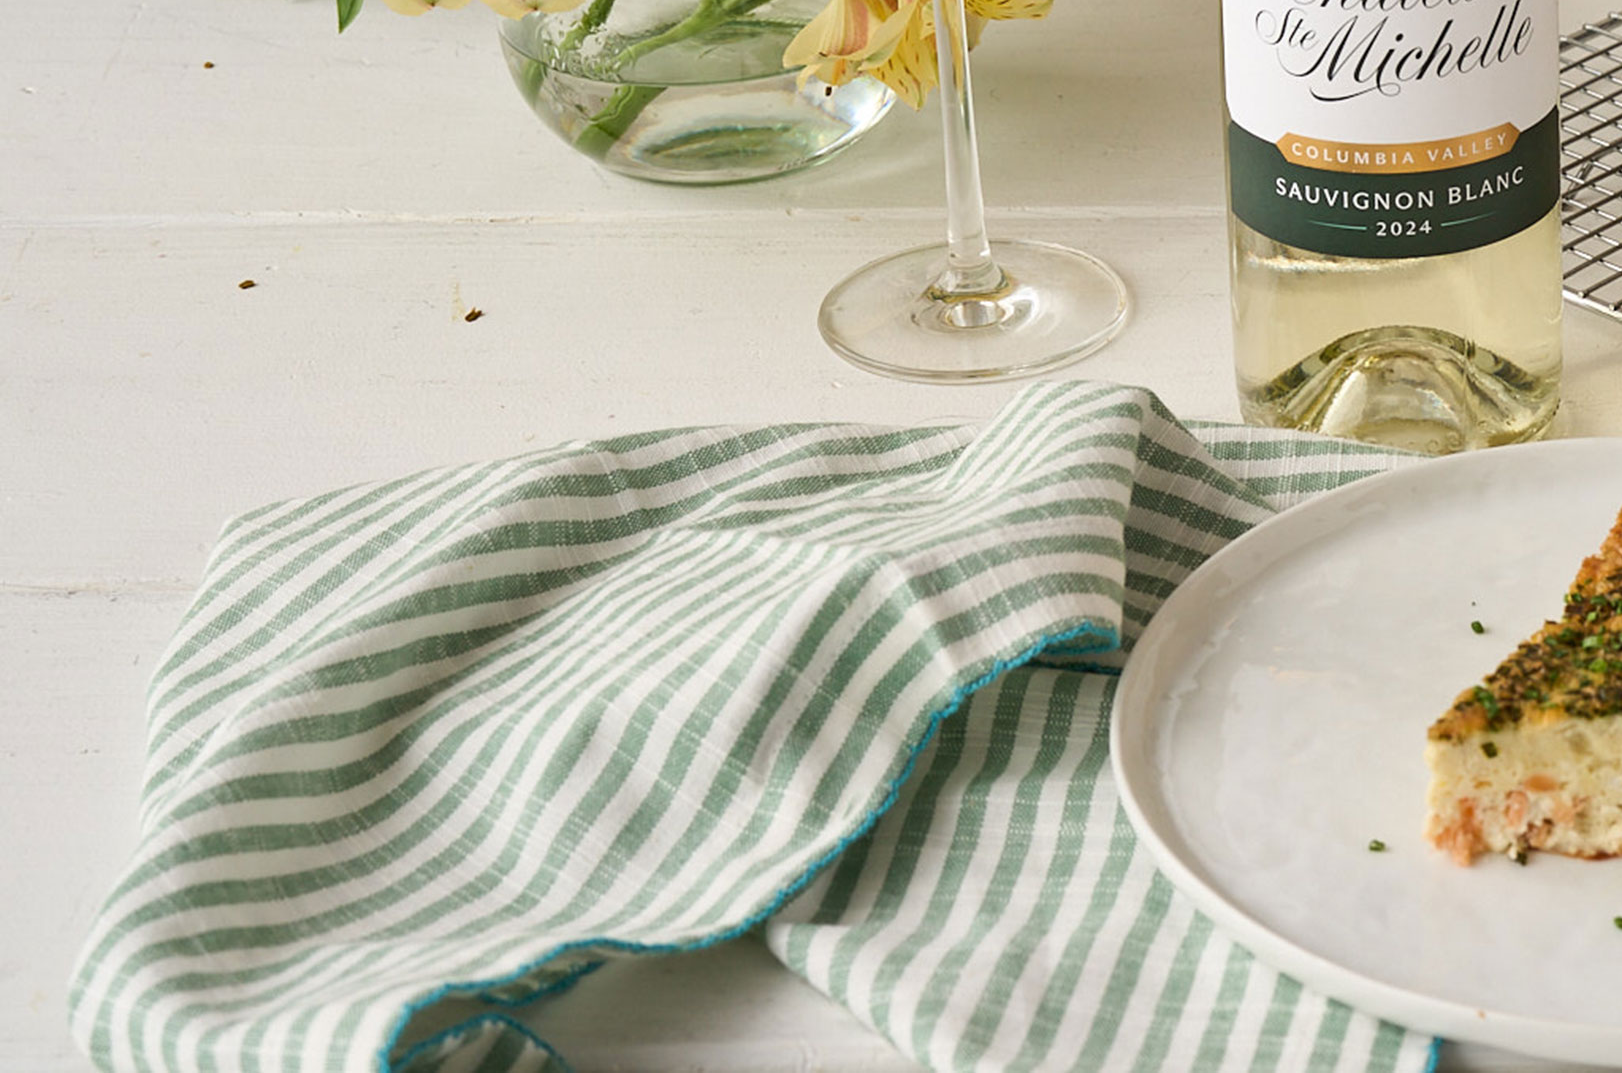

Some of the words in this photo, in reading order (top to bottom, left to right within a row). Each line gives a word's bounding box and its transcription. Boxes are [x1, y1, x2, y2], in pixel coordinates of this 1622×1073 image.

[1255, 7, 1320, 51] Ste
[1291, 142, 1415, 166] COLUMBIA
[1427, 132, 1508, 162] VALLEY
[1274, 177, 1435, 210] SAUVIGNON
[1447, 165, 1525, 206] BLANC
[1375, 221, 1433, 237] 2024
